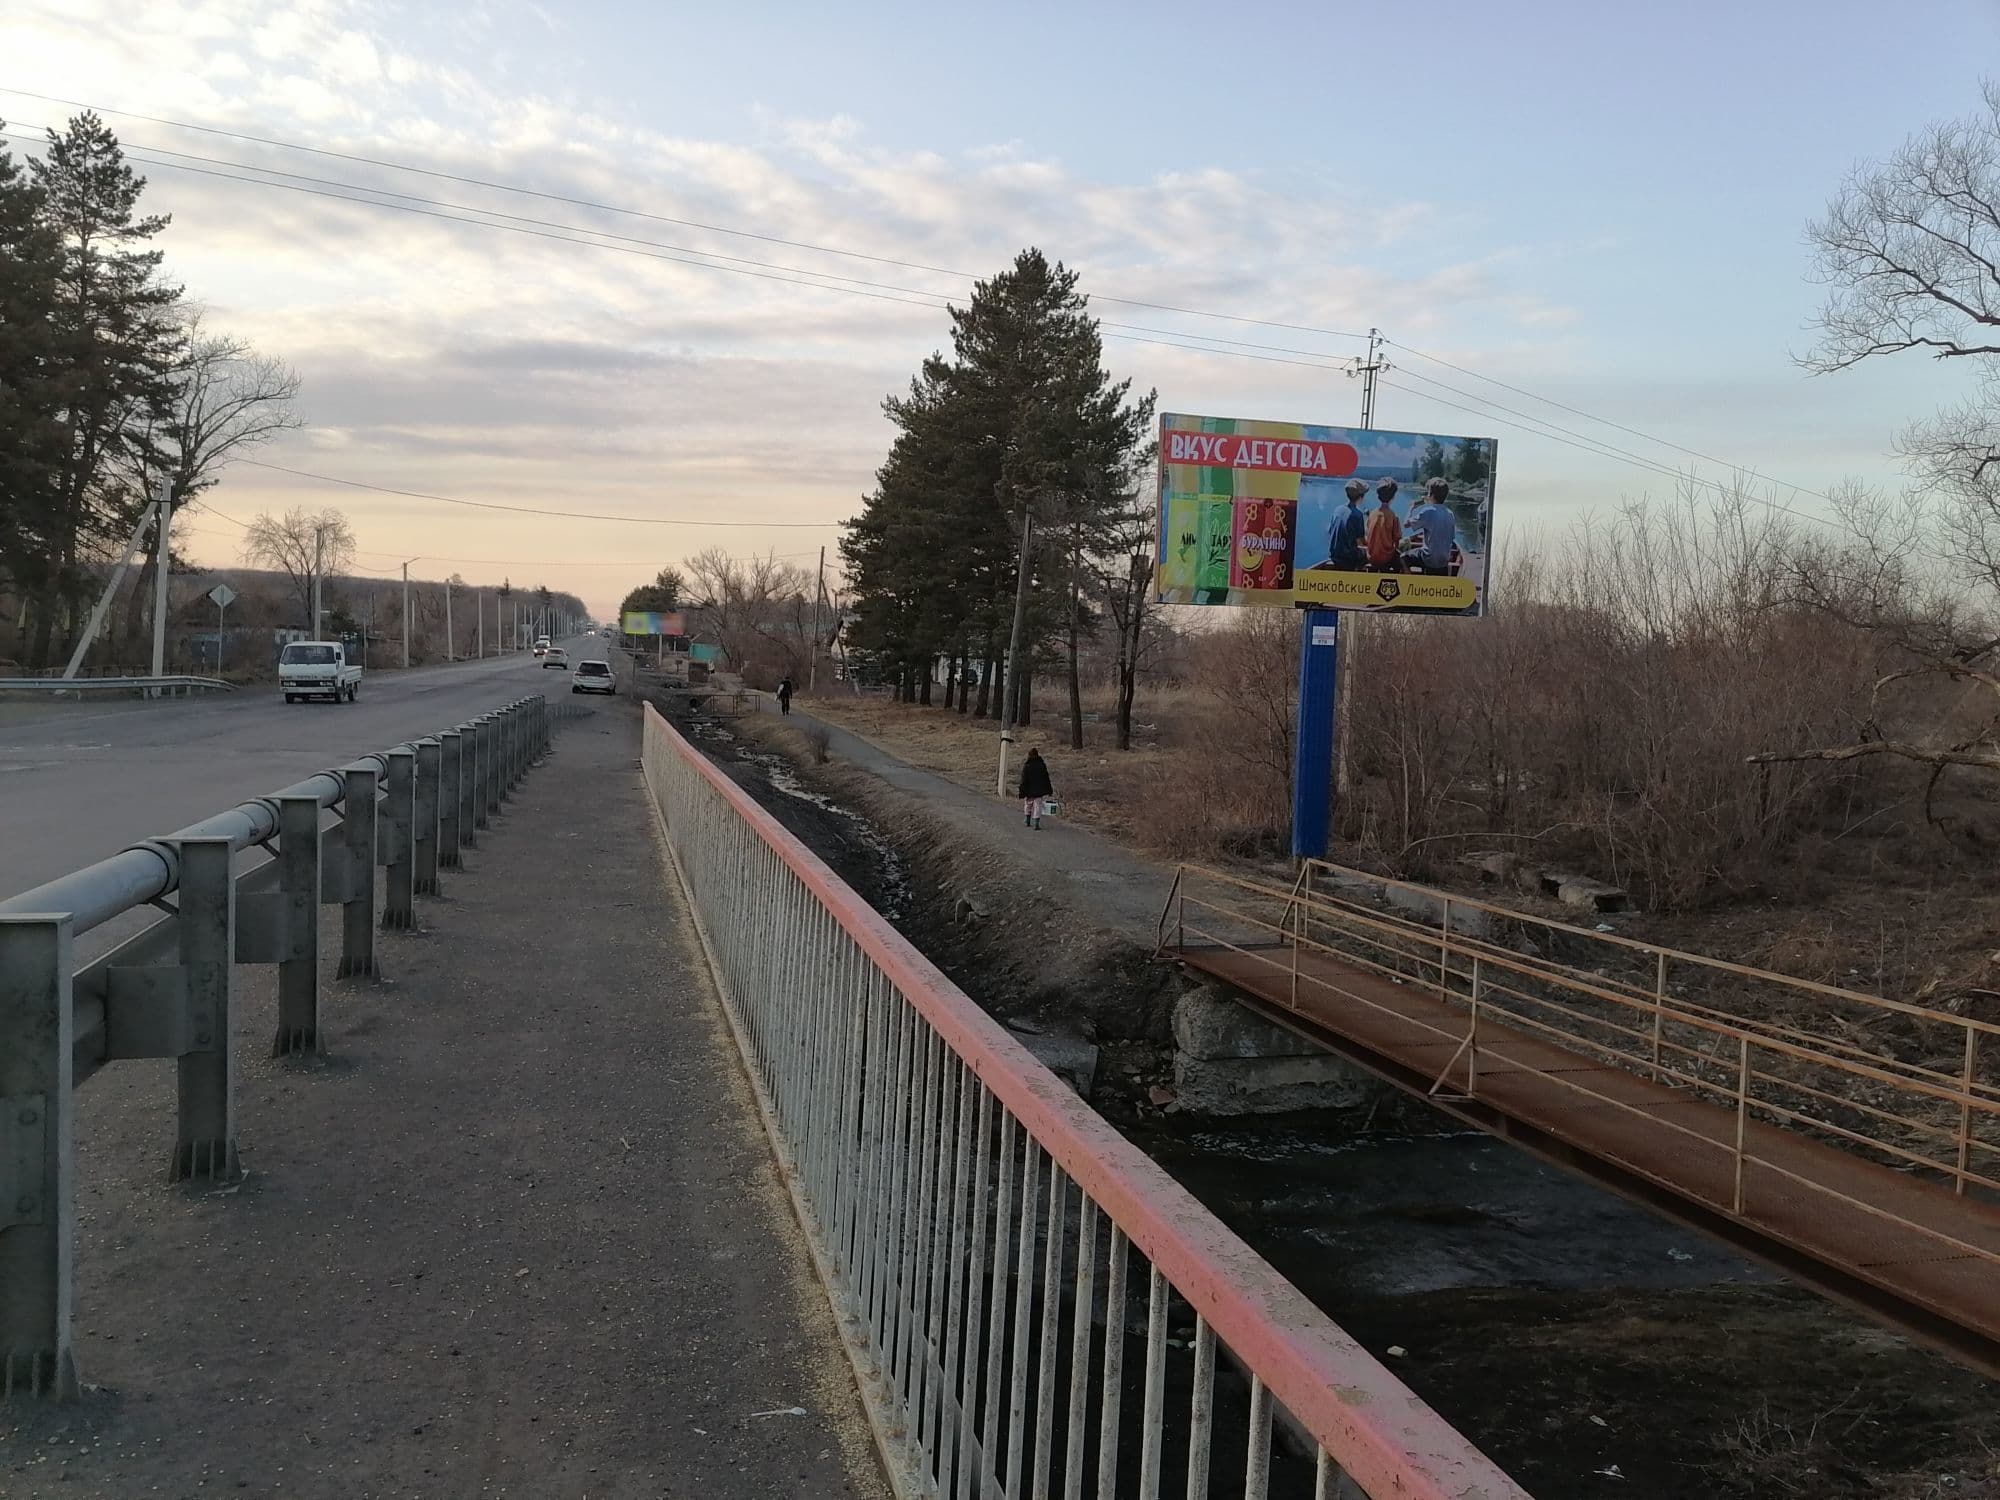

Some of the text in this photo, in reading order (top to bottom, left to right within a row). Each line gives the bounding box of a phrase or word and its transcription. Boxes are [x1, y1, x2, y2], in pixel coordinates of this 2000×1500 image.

[1170, 434, 1327, 470] ВКУС ДЕТСТВА
[1241, 535, 1287, 551] БУРАТИНО
[1298, 578, 1463, 598] Шмаковские Лимонады
